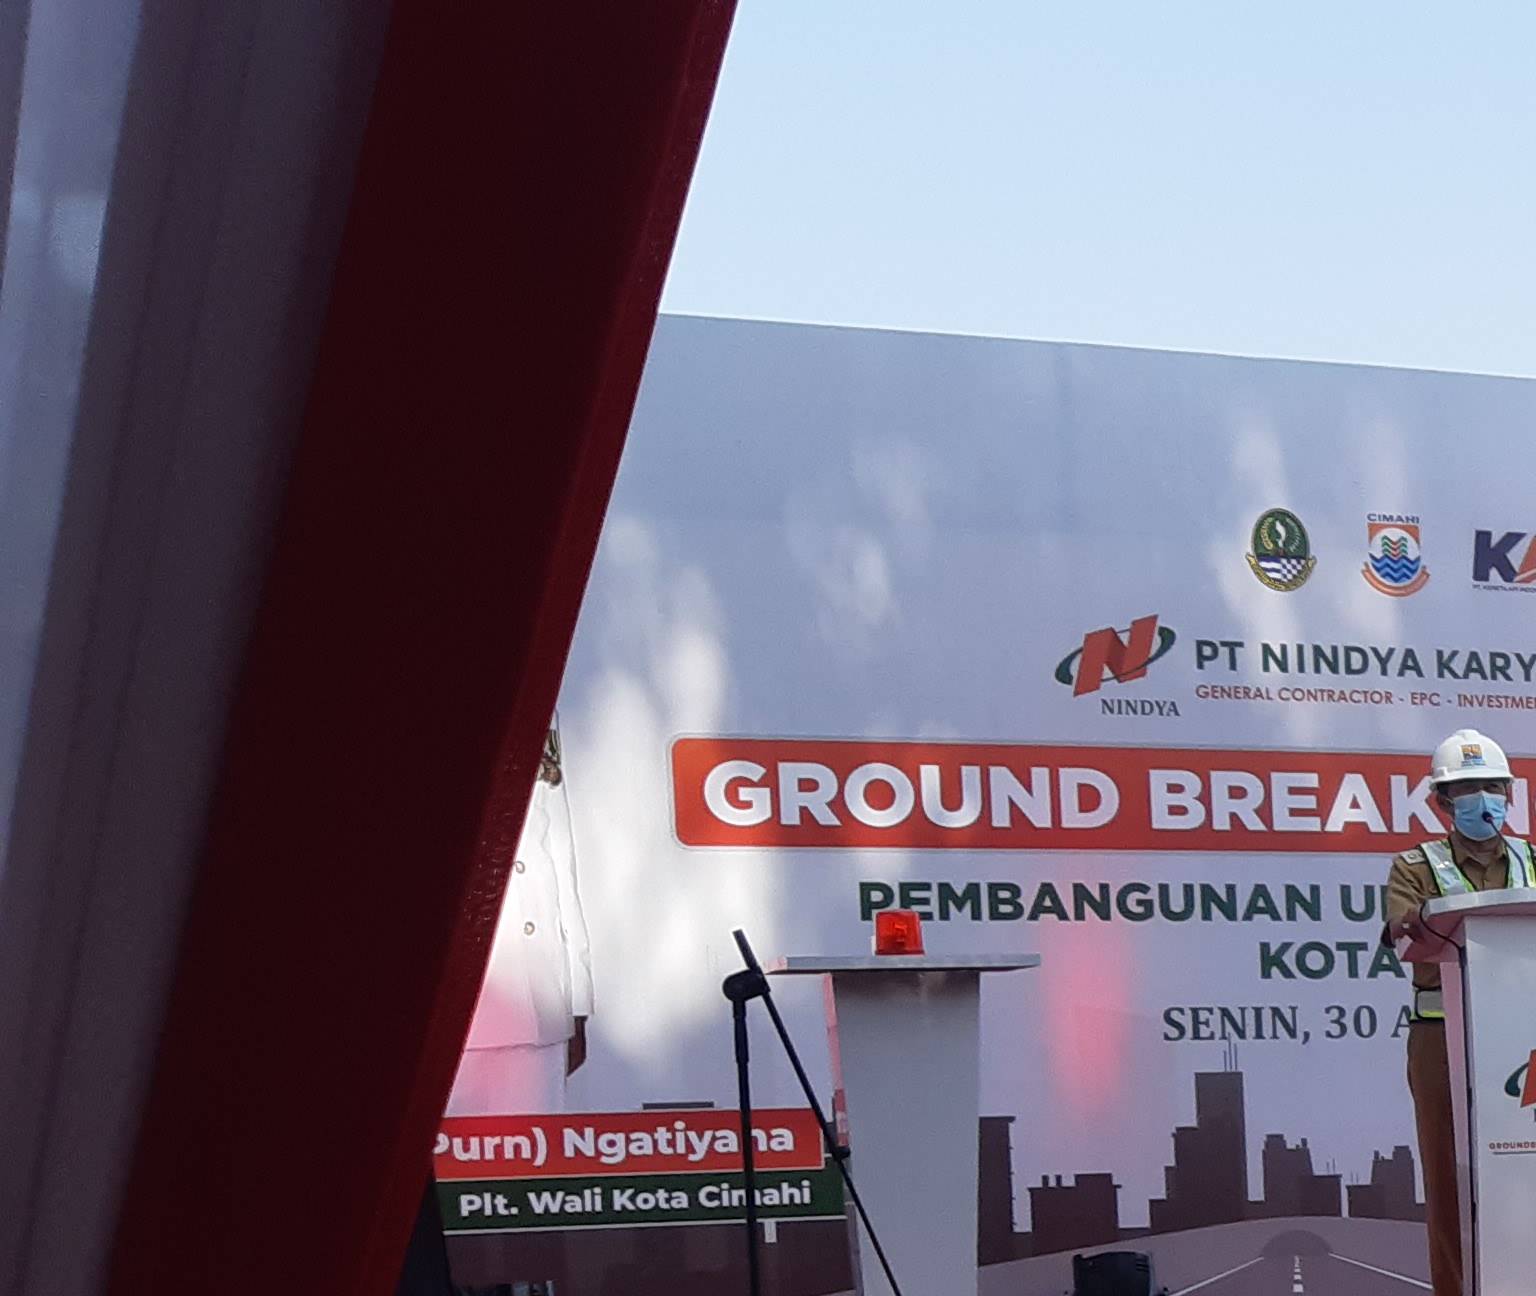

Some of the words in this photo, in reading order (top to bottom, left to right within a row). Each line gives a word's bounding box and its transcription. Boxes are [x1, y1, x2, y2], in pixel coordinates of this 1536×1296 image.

[1366, 513, 1420, 524] CIMAHI
[1195, 640, 1244, 672] PT
[1262, 644, 1423, 679] NINDYA
[1101, 699, 1180, 716] NINDYA
[1195, 684, 1274, 701] GENERAL
[1277, 687, 1393, 705] CONTRACTOR
[1410, 694, 1441, 707] EPC
[703, 760, 1121, 830] GROUND
[858, 881, 1322, 922] PEMBANGUNAN
[1260, 940, 1407, 979] KOTA
[1162, 1005, 1311, 1046] SENIN,
[1323, 1004, 1378, 1039] 30
[563, 1121, 795, 1164] Ngatiyana
[460, 1193, 519, 1217] Plt.
[527, 1187, 603, 1216] Wali
[613, 1187, 689, 1212] Kota
[698, 1180, 811, 1208] Cimahi
